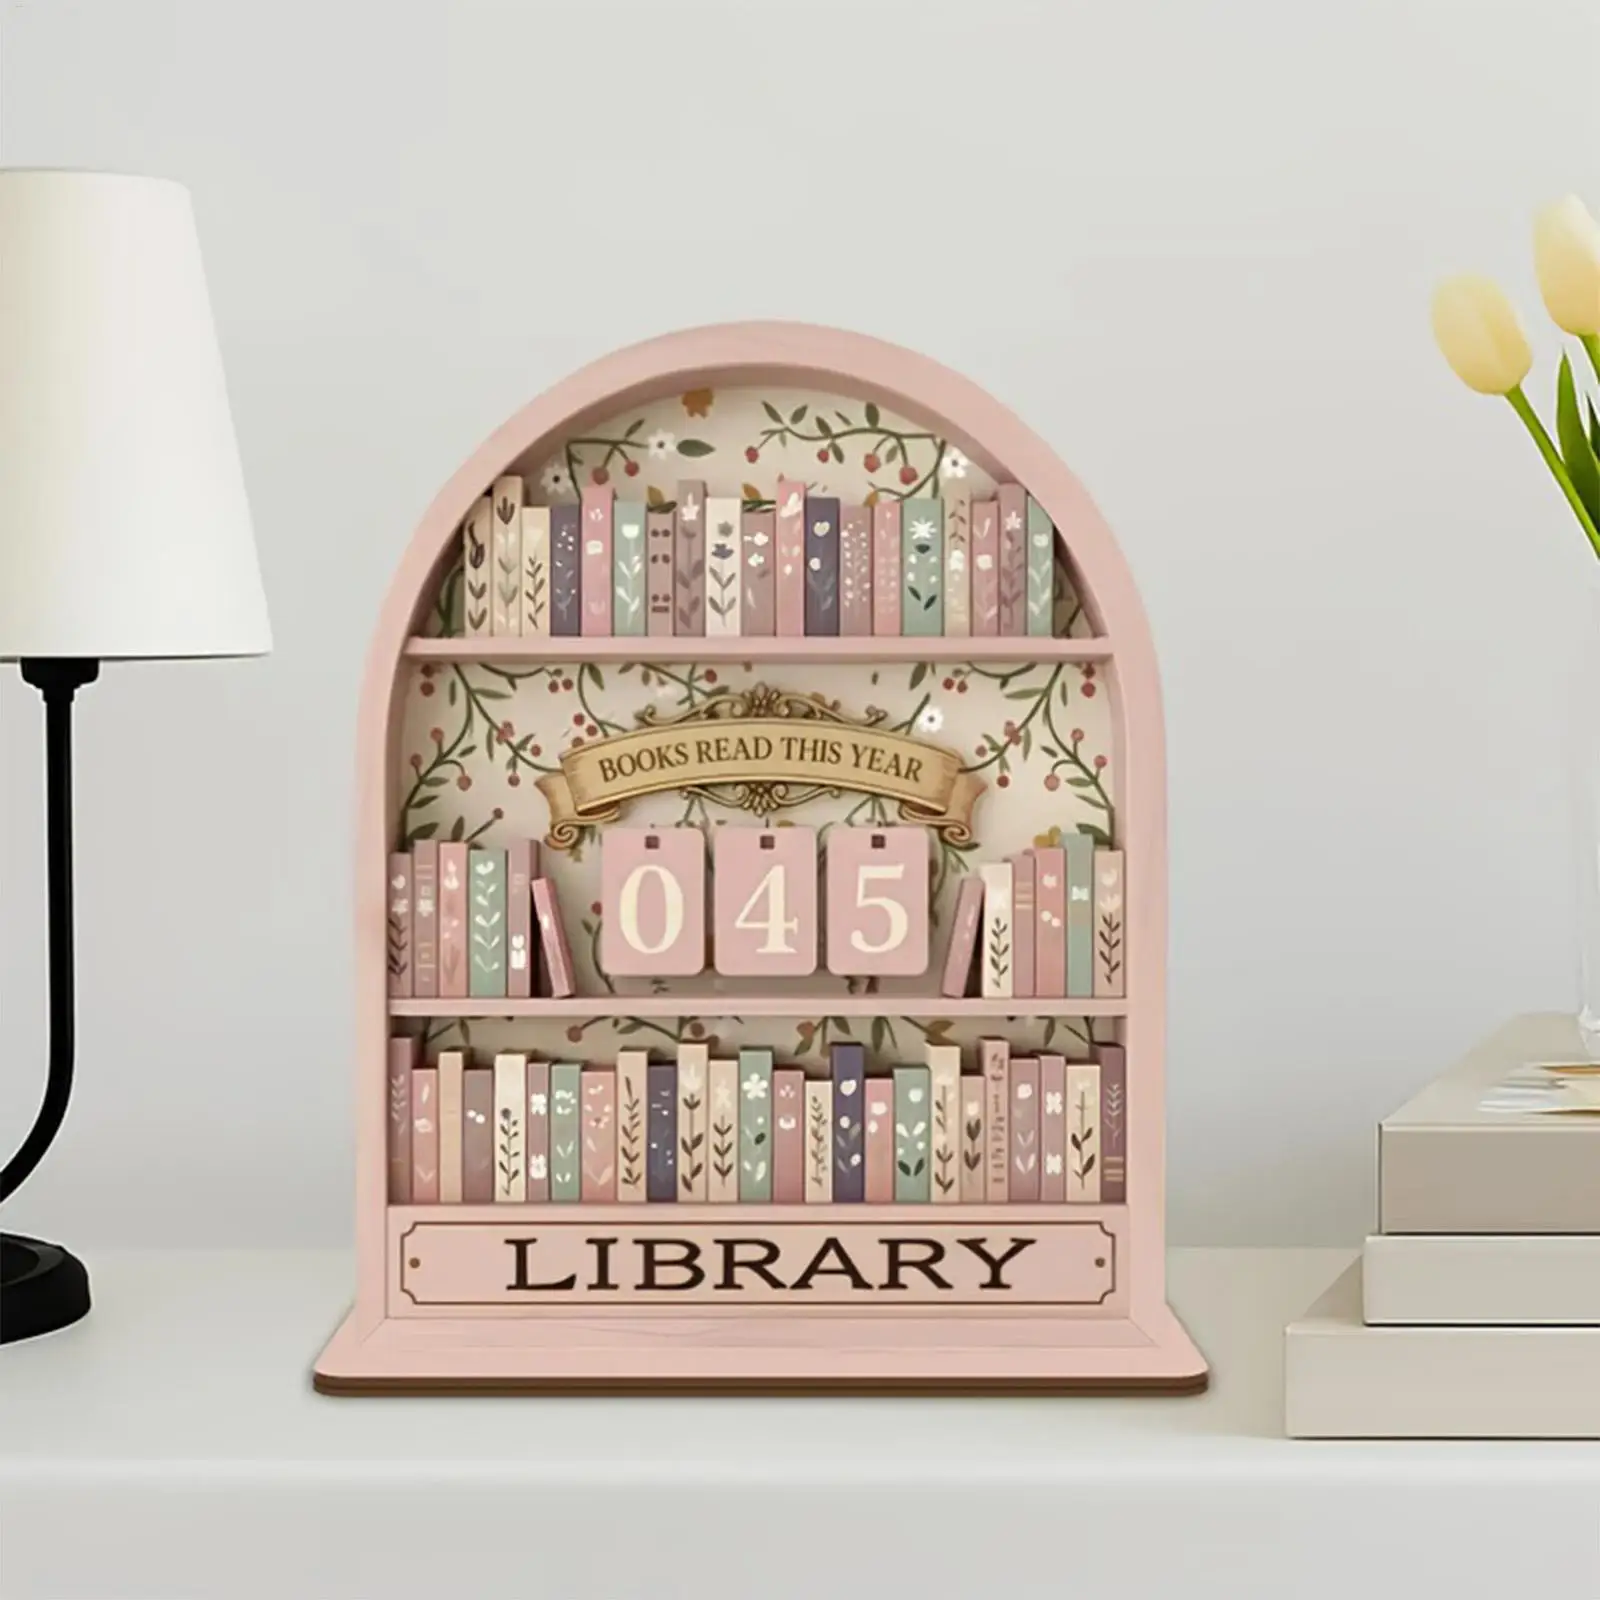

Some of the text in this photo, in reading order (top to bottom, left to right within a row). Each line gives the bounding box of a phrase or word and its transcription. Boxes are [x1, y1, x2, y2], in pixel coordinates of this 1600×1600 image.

[598, 736, 924, 783] BOOKS READ THIS YEAR
[504, 1238, 1037, 1291] LIBRARY
